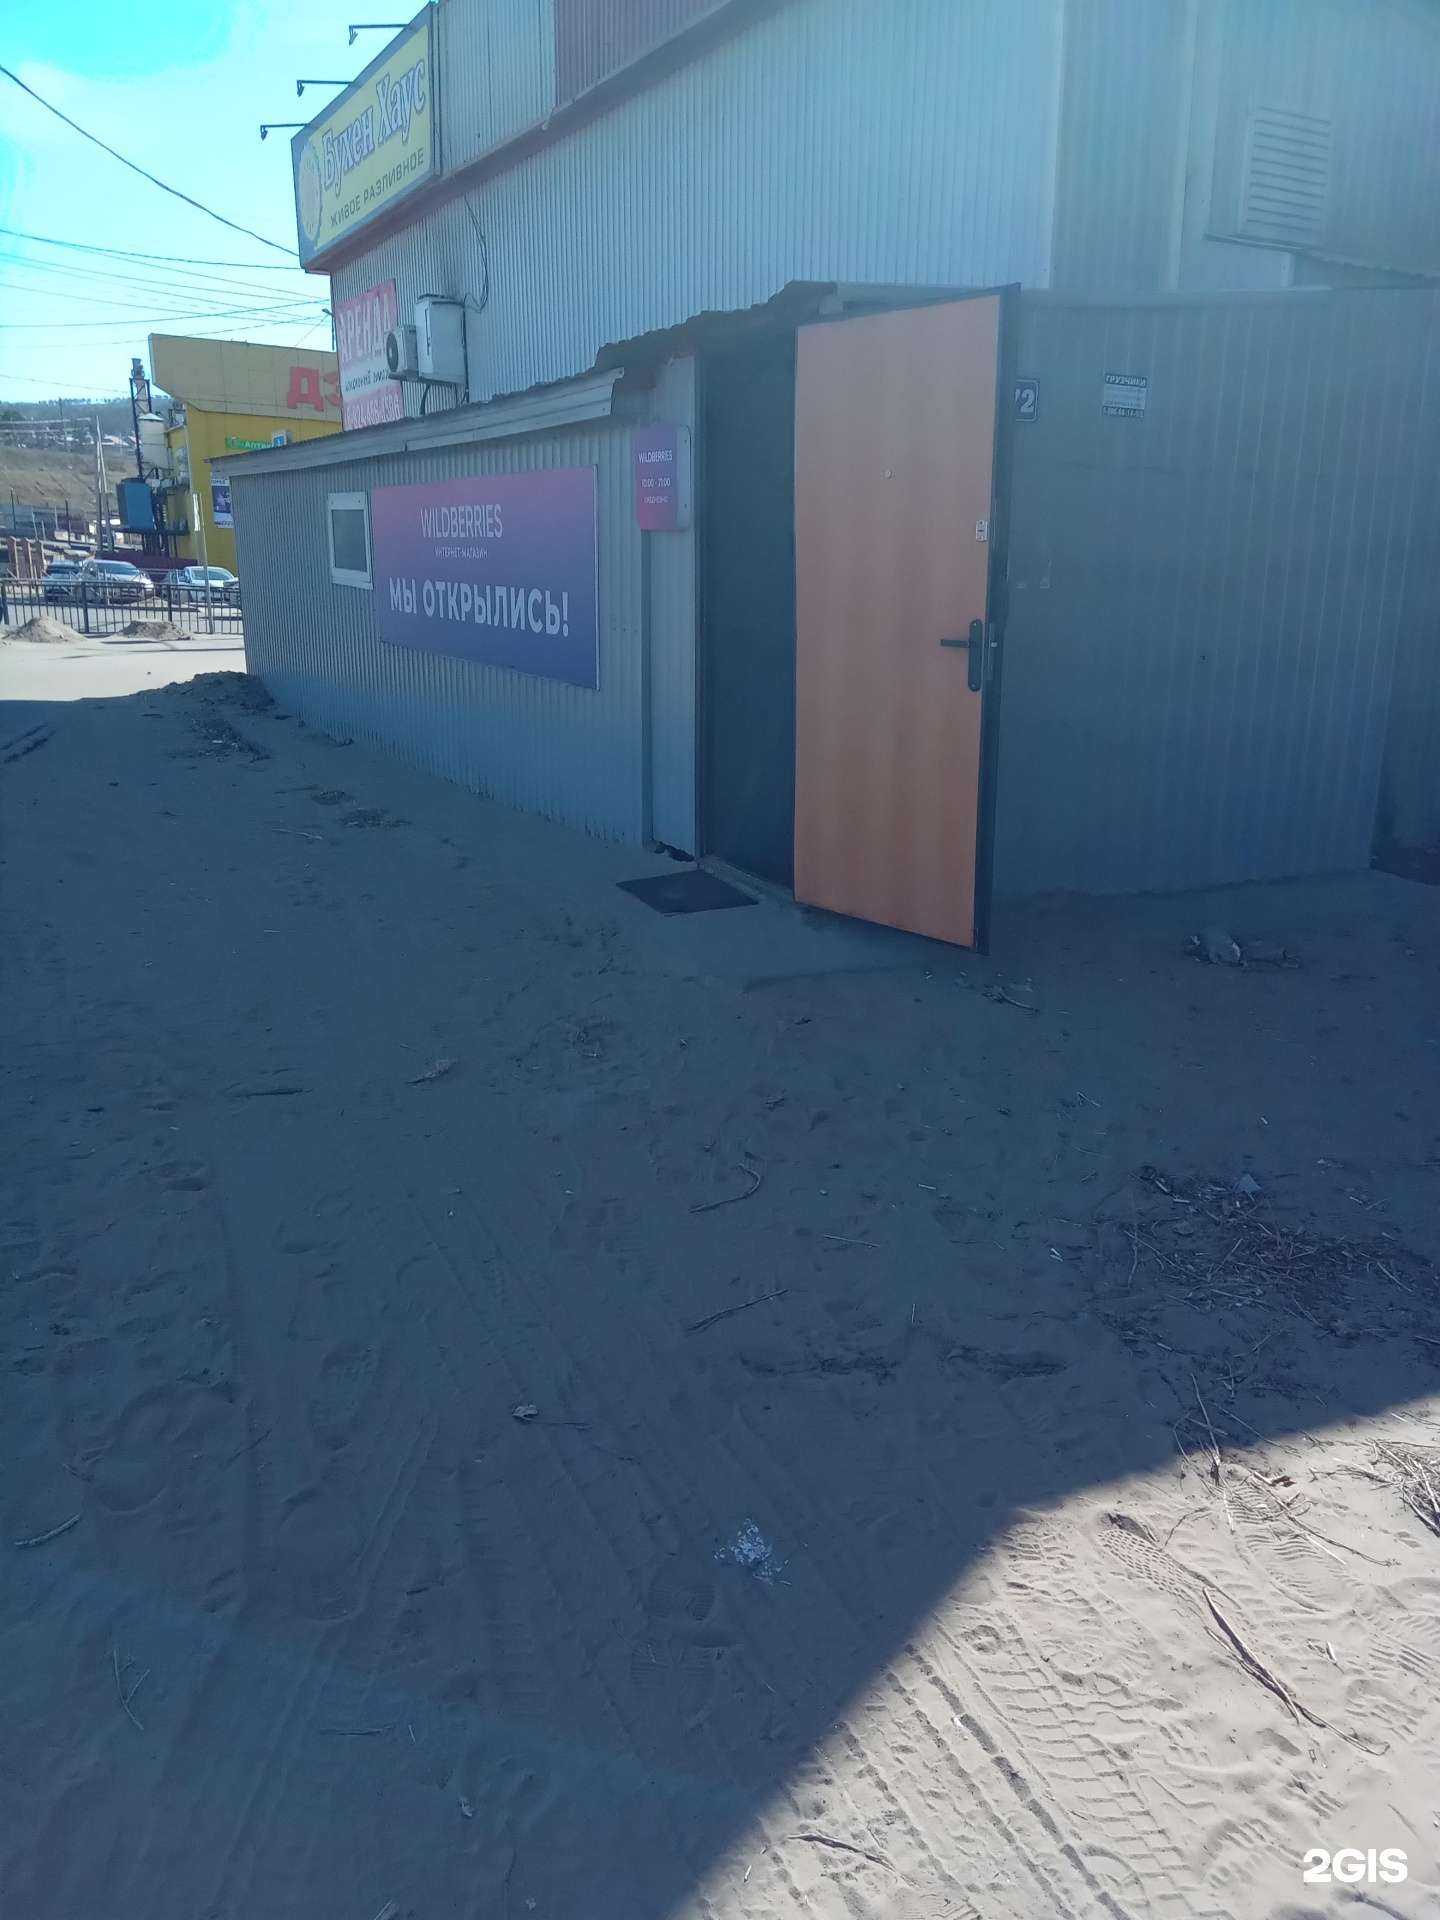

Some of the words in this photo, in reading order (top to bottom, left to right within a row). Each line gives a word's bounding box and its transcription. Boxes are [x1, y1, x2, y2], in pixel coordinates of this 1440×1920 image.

[321, 105, 376, 199] Бухен
[376, 59, 427, 147] Хаус
[331, 194, 361, 226] ЖИВОЕ
[363, 147, 425, 203] РАЗЛИВНОЕ
[1105, 374, 1147, 387] ГРУЗЧИКИ
[638, 449, 673, 464] WILDBERRIES
[420, 503, 504, 538] WILDBERRIES
[434, 545, 489, 560] ИНТЕРНЕТ-МАГАЗИН
[389, 576, 418, 615] МЫ
[422, 579, 570, 638] ОТКРЫЛИСЬ!
